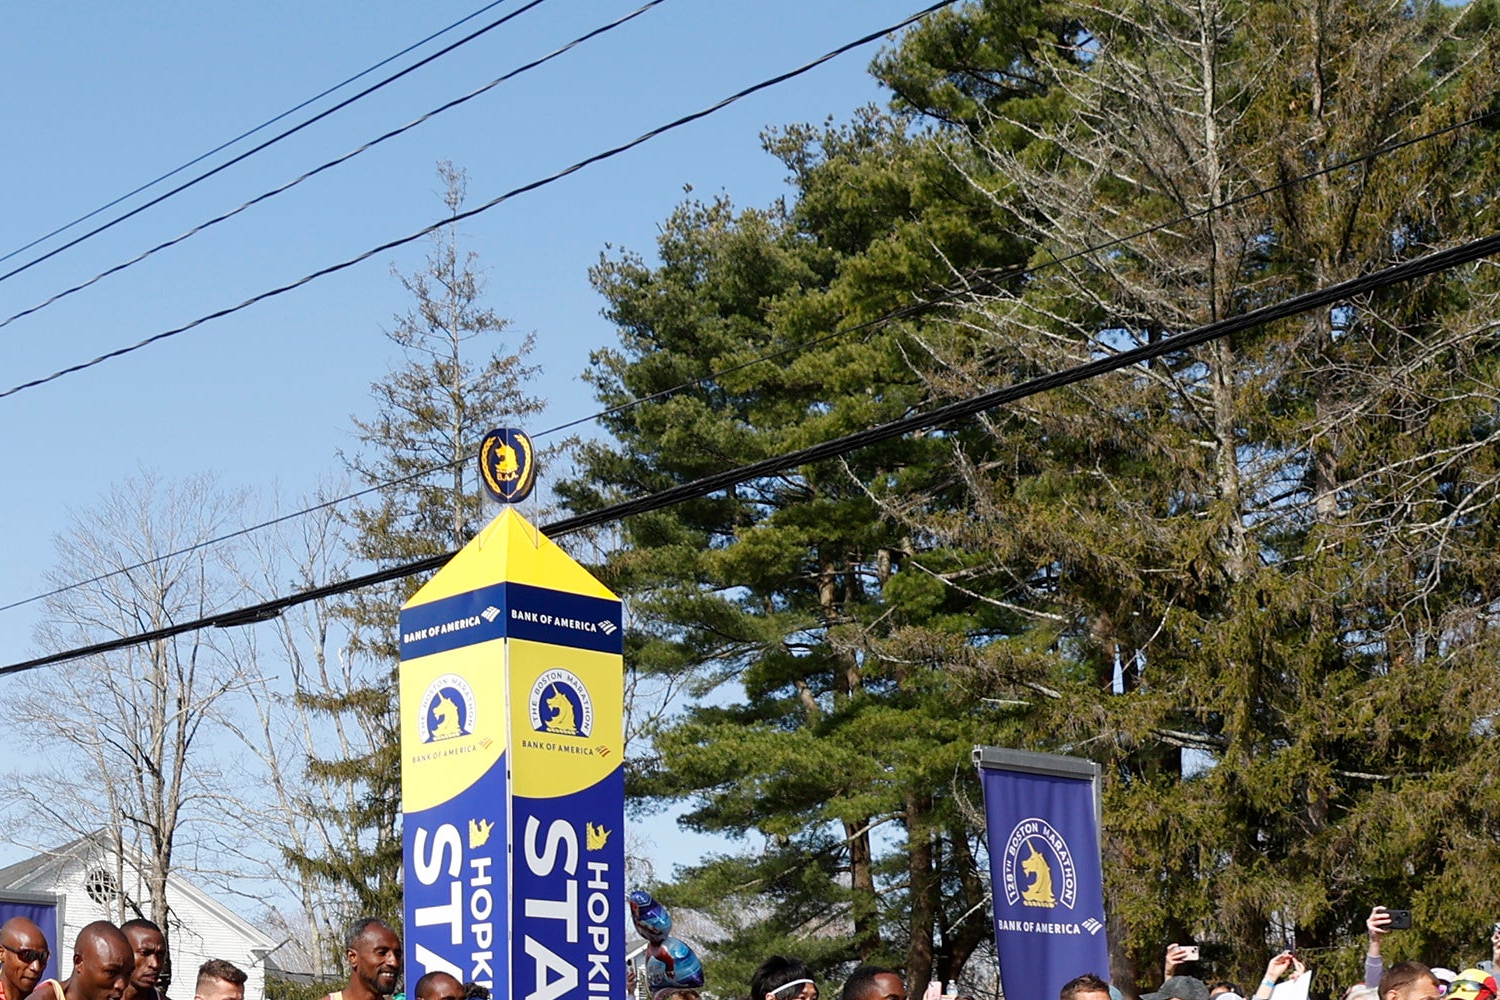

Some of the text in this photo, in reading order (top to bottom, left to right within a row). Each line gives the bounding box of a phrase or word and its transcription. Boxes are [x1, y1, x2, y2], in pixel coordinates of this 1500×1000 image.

[404, 615, 481, 643] BANK OF AMERICA
[511, 609, 597, 632] BANK OF AMERICA
[531, 672, 591, 730] THE BOSTON MARATHON
[412, 745, 477, 764] BANK OF AMERICA
[522, 740, 594, 756] BANK OF AMERICA
[1008, 822, 1039, 857] BOSTON
[1043, 826, 1074, 900] MARATHON
[998, 919, 1081, 934] BANK OF AMERICA
